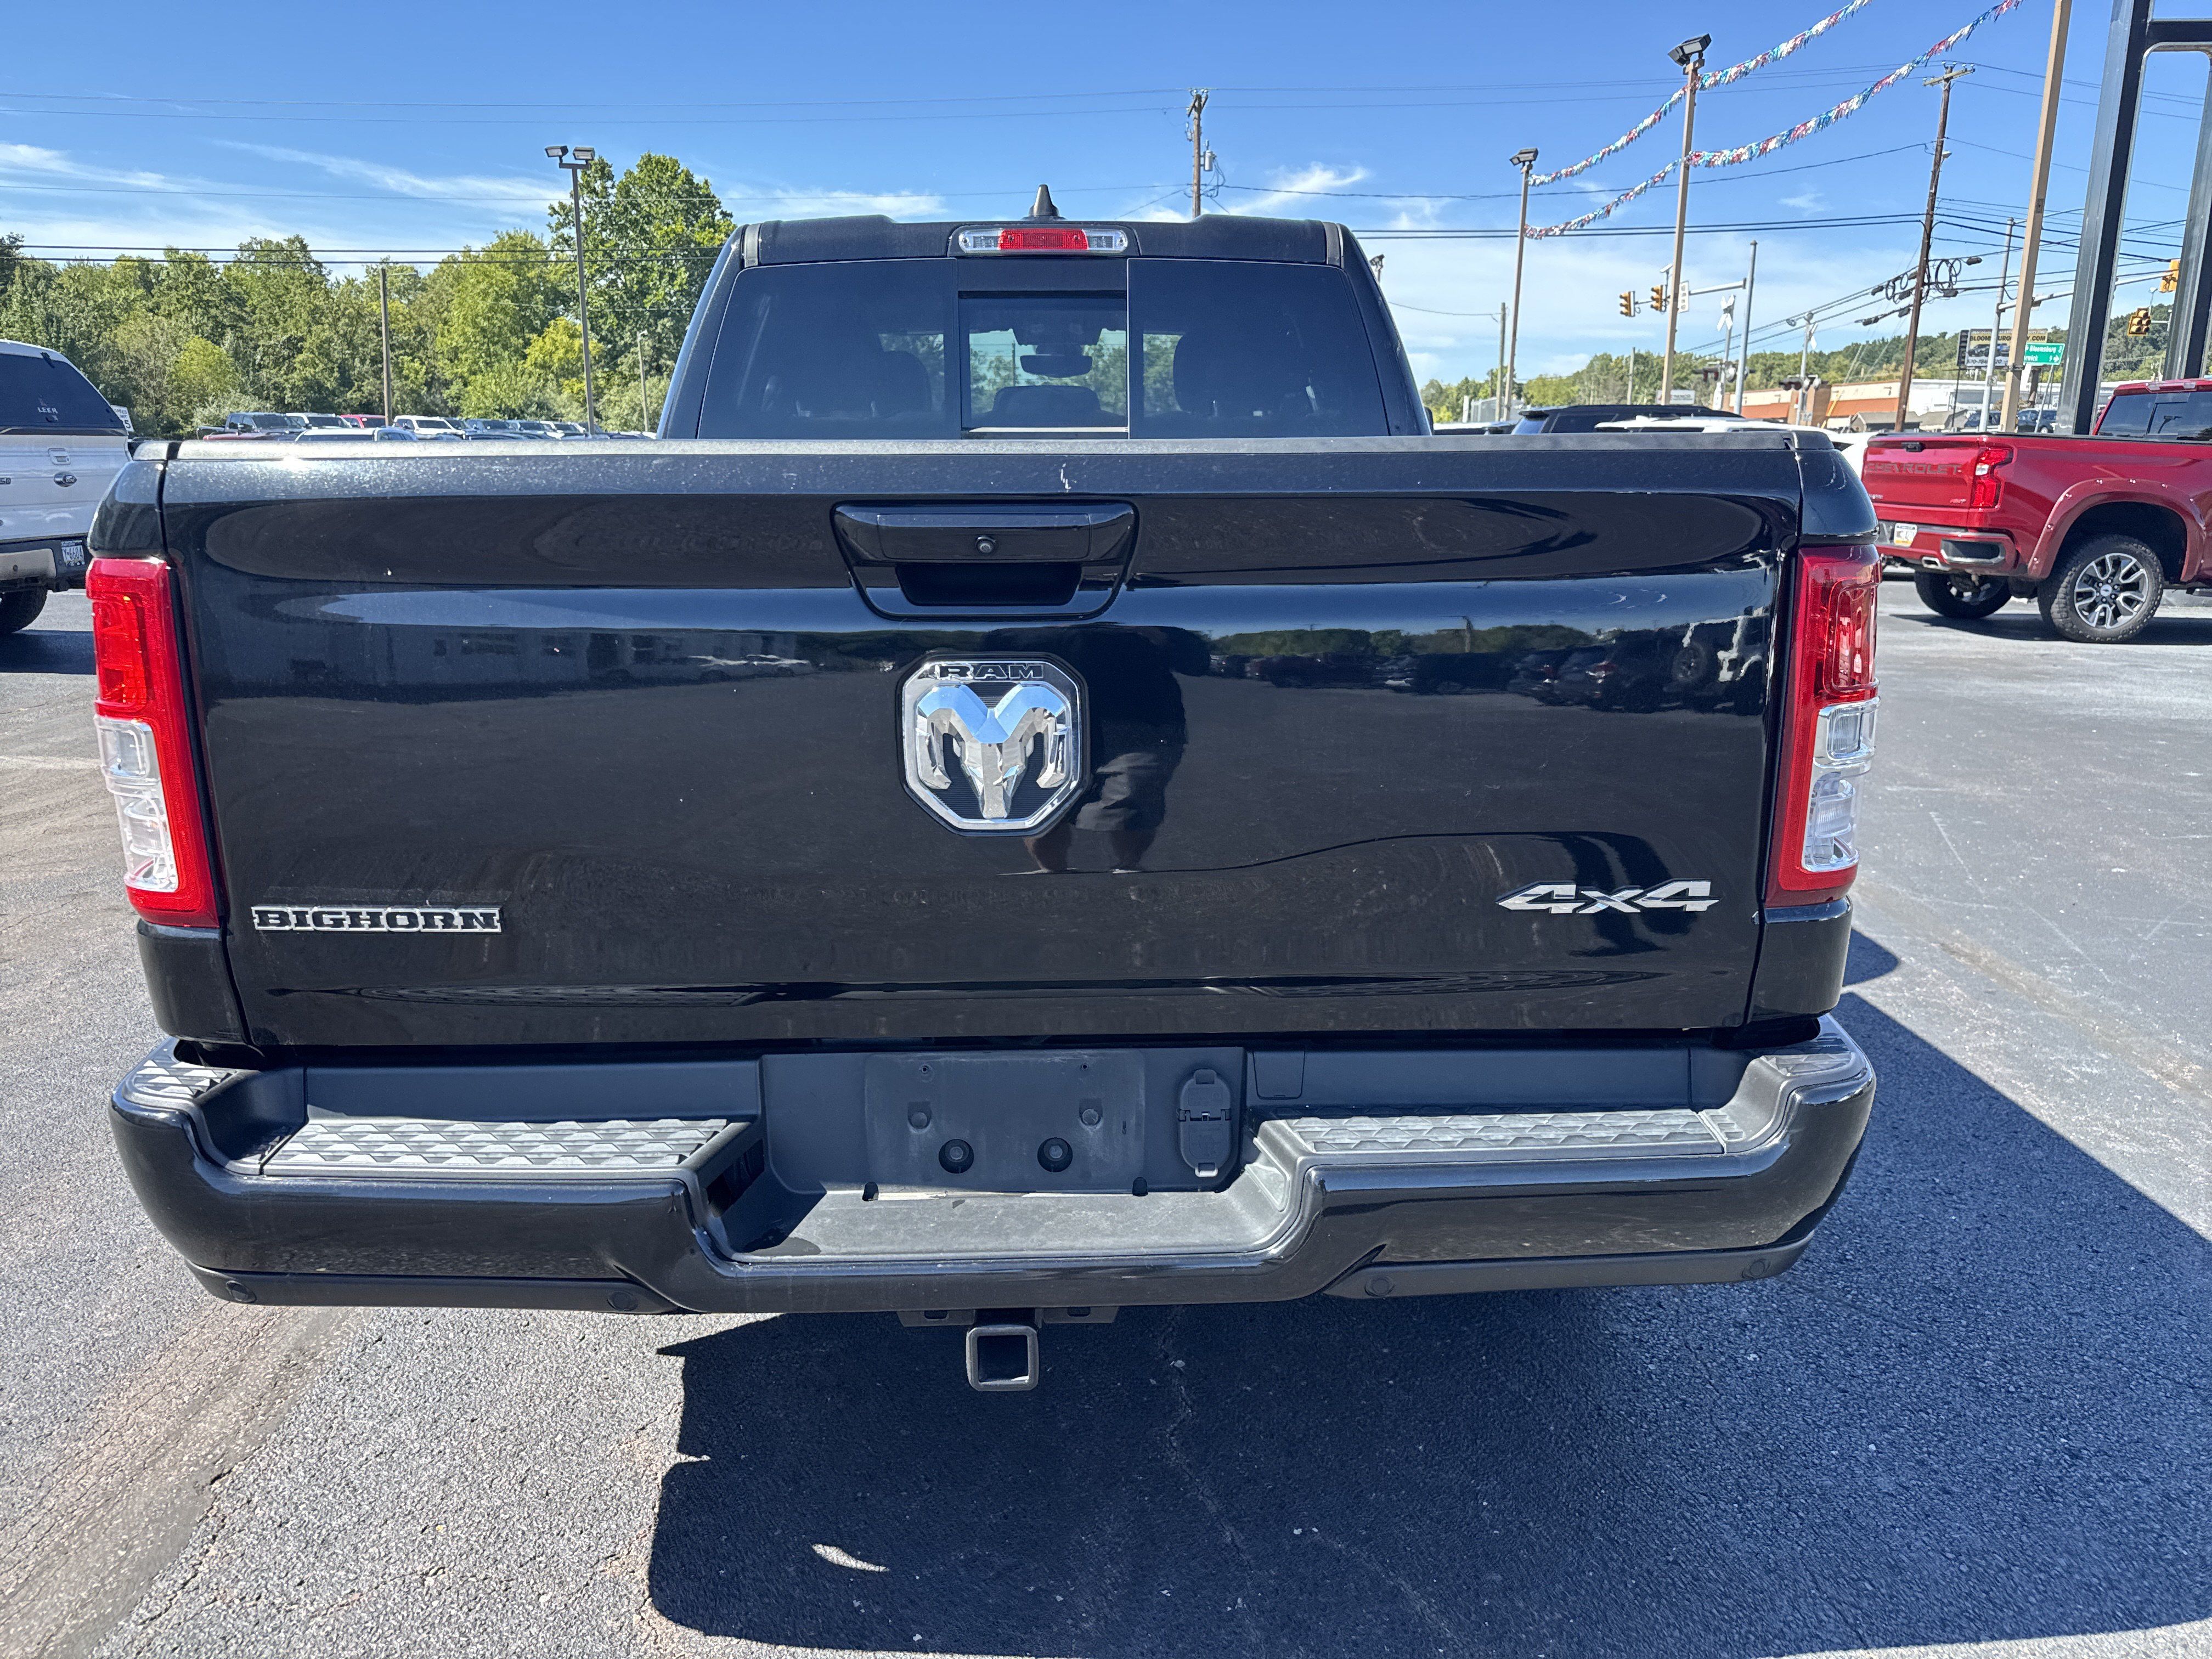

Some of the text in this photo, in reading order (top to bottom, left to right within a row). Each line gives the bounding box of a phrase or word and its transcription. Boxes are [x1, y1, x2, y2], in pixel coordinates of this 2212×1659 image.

[2029, 345, 2057, 353] Bloomsburg
[124, 420, 131, 428] 5
[1866, 463, 1962, 476] CHEVROLET
[935, 663, 1043, 680] RAM
[251, 906, 502, 933] BIGHORN
